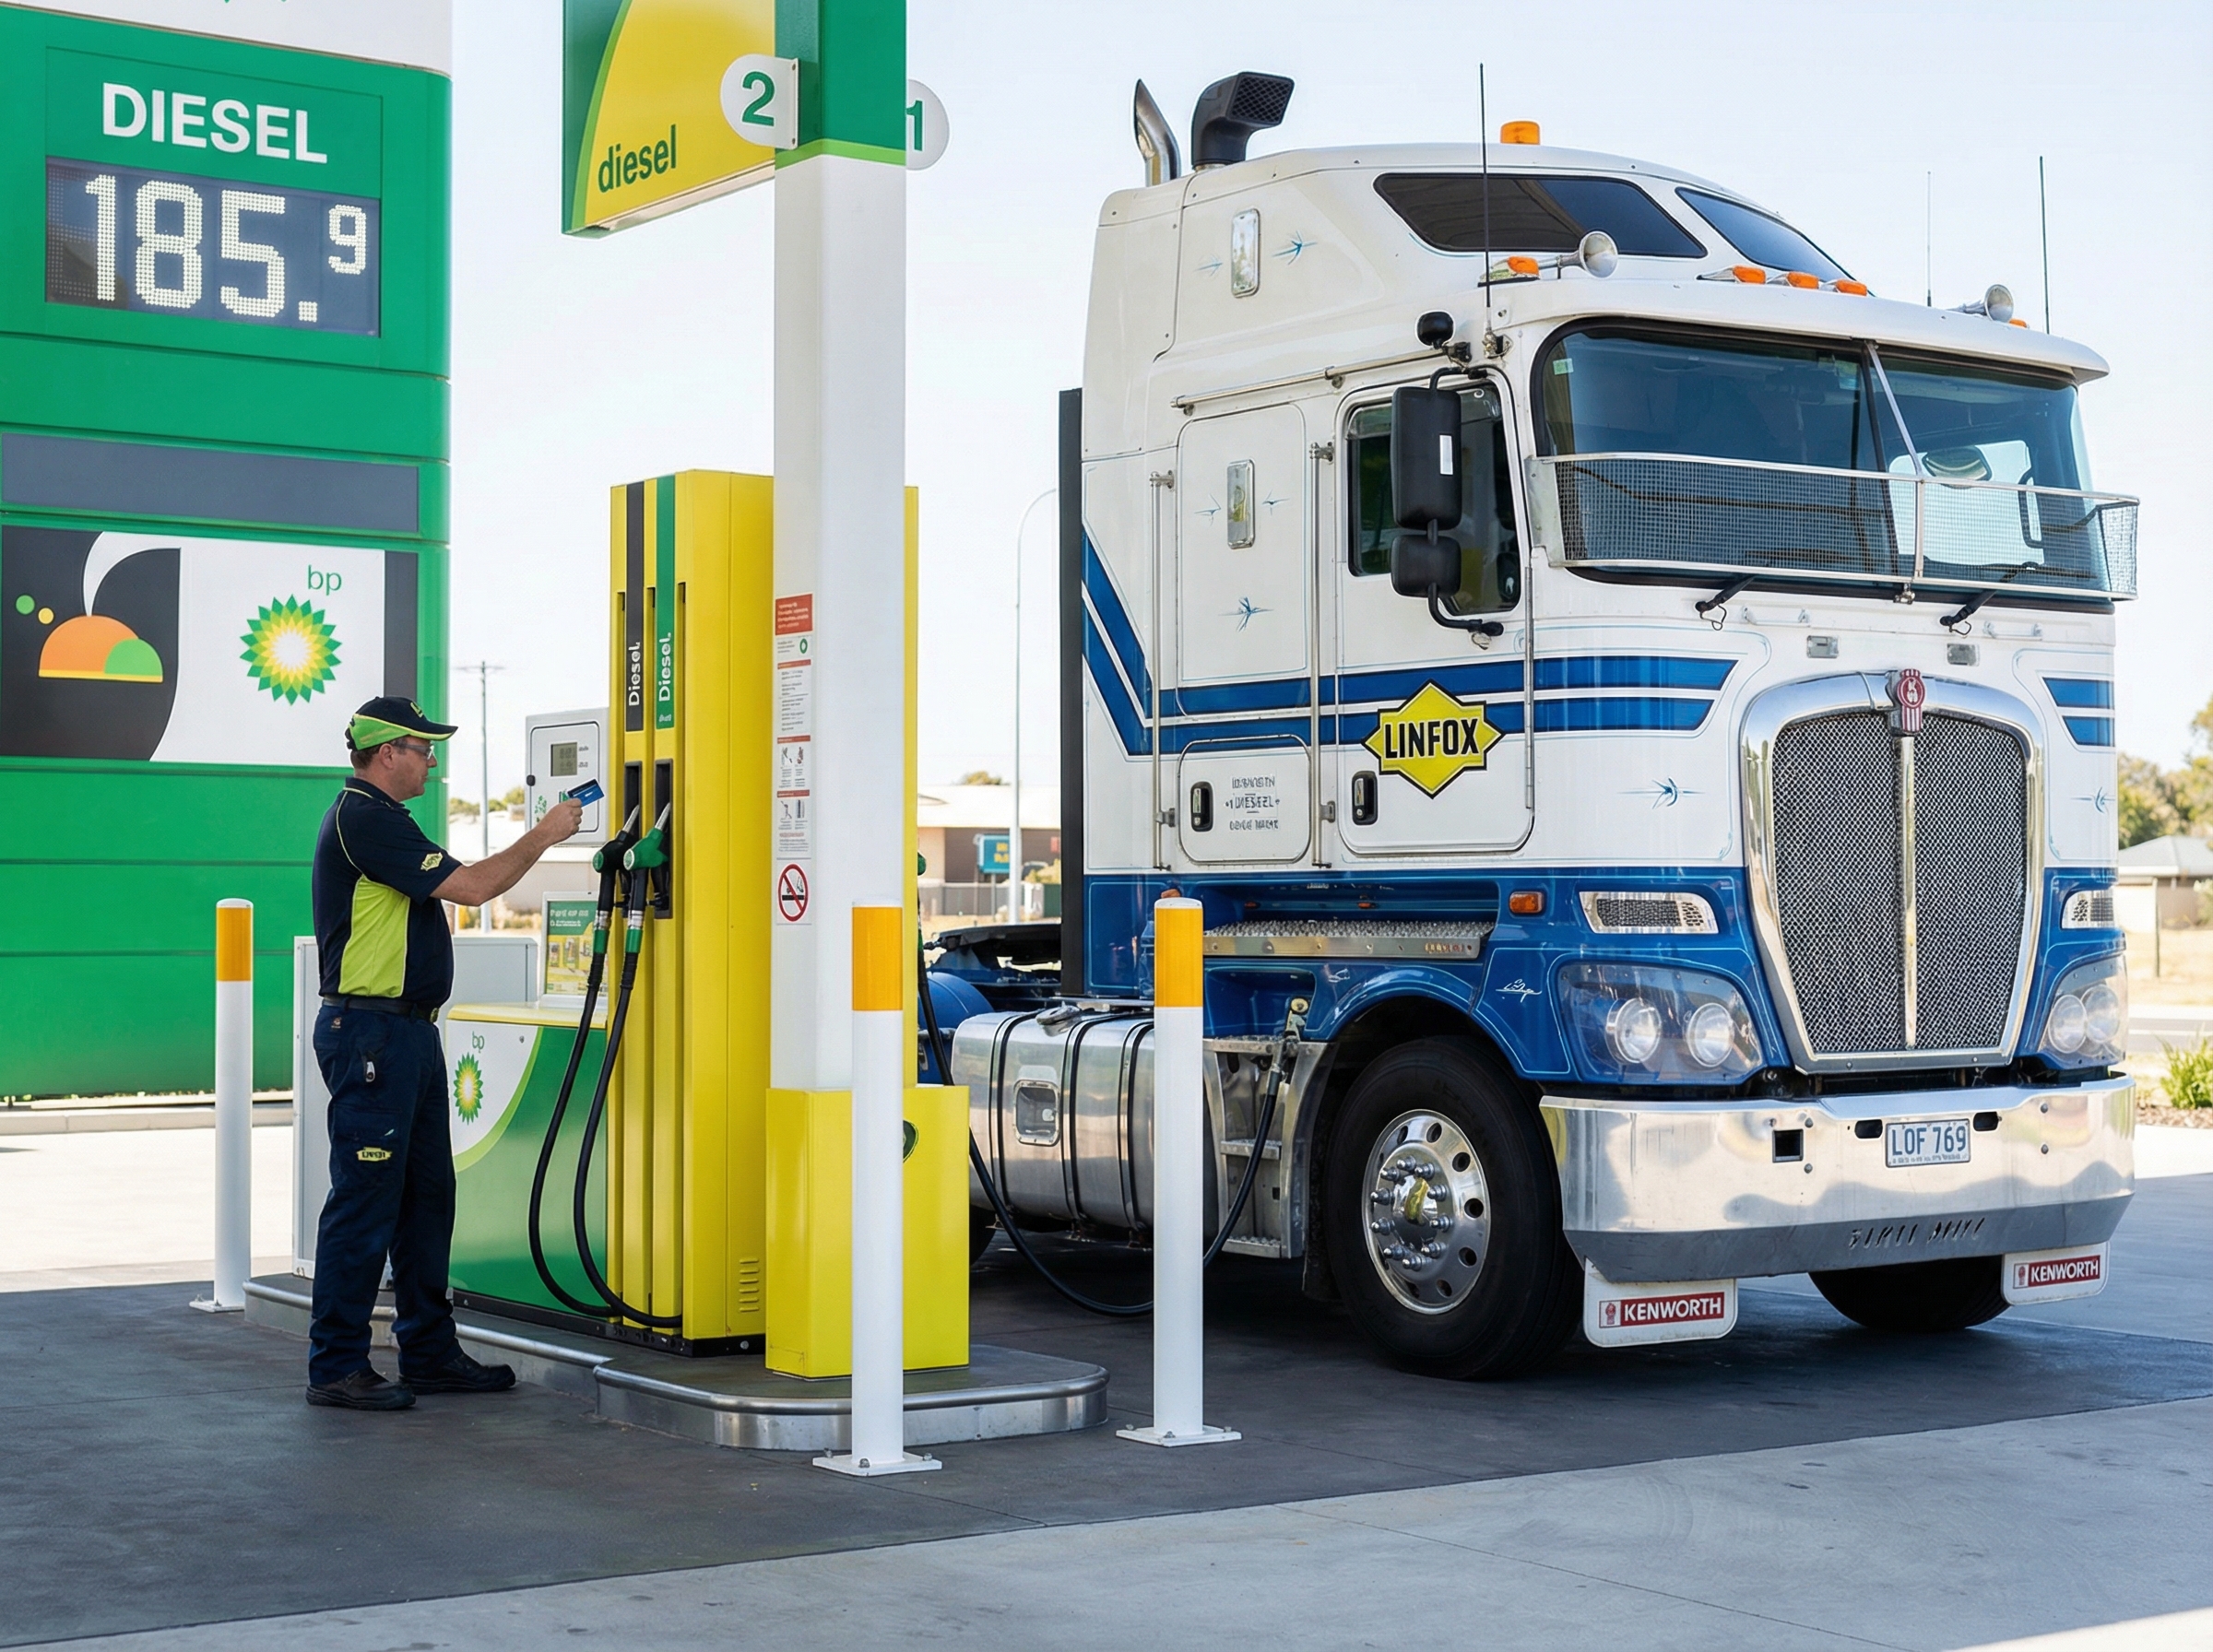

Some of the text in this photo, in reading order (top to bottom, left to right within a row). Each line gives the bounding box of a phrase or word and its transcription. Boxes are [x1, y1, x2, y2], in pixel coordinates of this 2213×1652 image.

[741, 70, 775, 127] 2
[102, 82, 327, 164] DIESEL
[906, 100, 924, 152] 1
[598, 124, 677, 193] diesel
[307, 564, 342, 596] bp
[628, 642, 641, 706] Diesel
[658, 631, 672, 702] Diesel
[1384, 718, 1479, 759] LINFOX
[472, 1031, 485, 1054] bp
[1891, 1126, 1966, 1156] LOF 769
[2030, 1259, 2099, 1283] KENWORTH
[1624, 1297, 1722, 1322] KENWORTH
